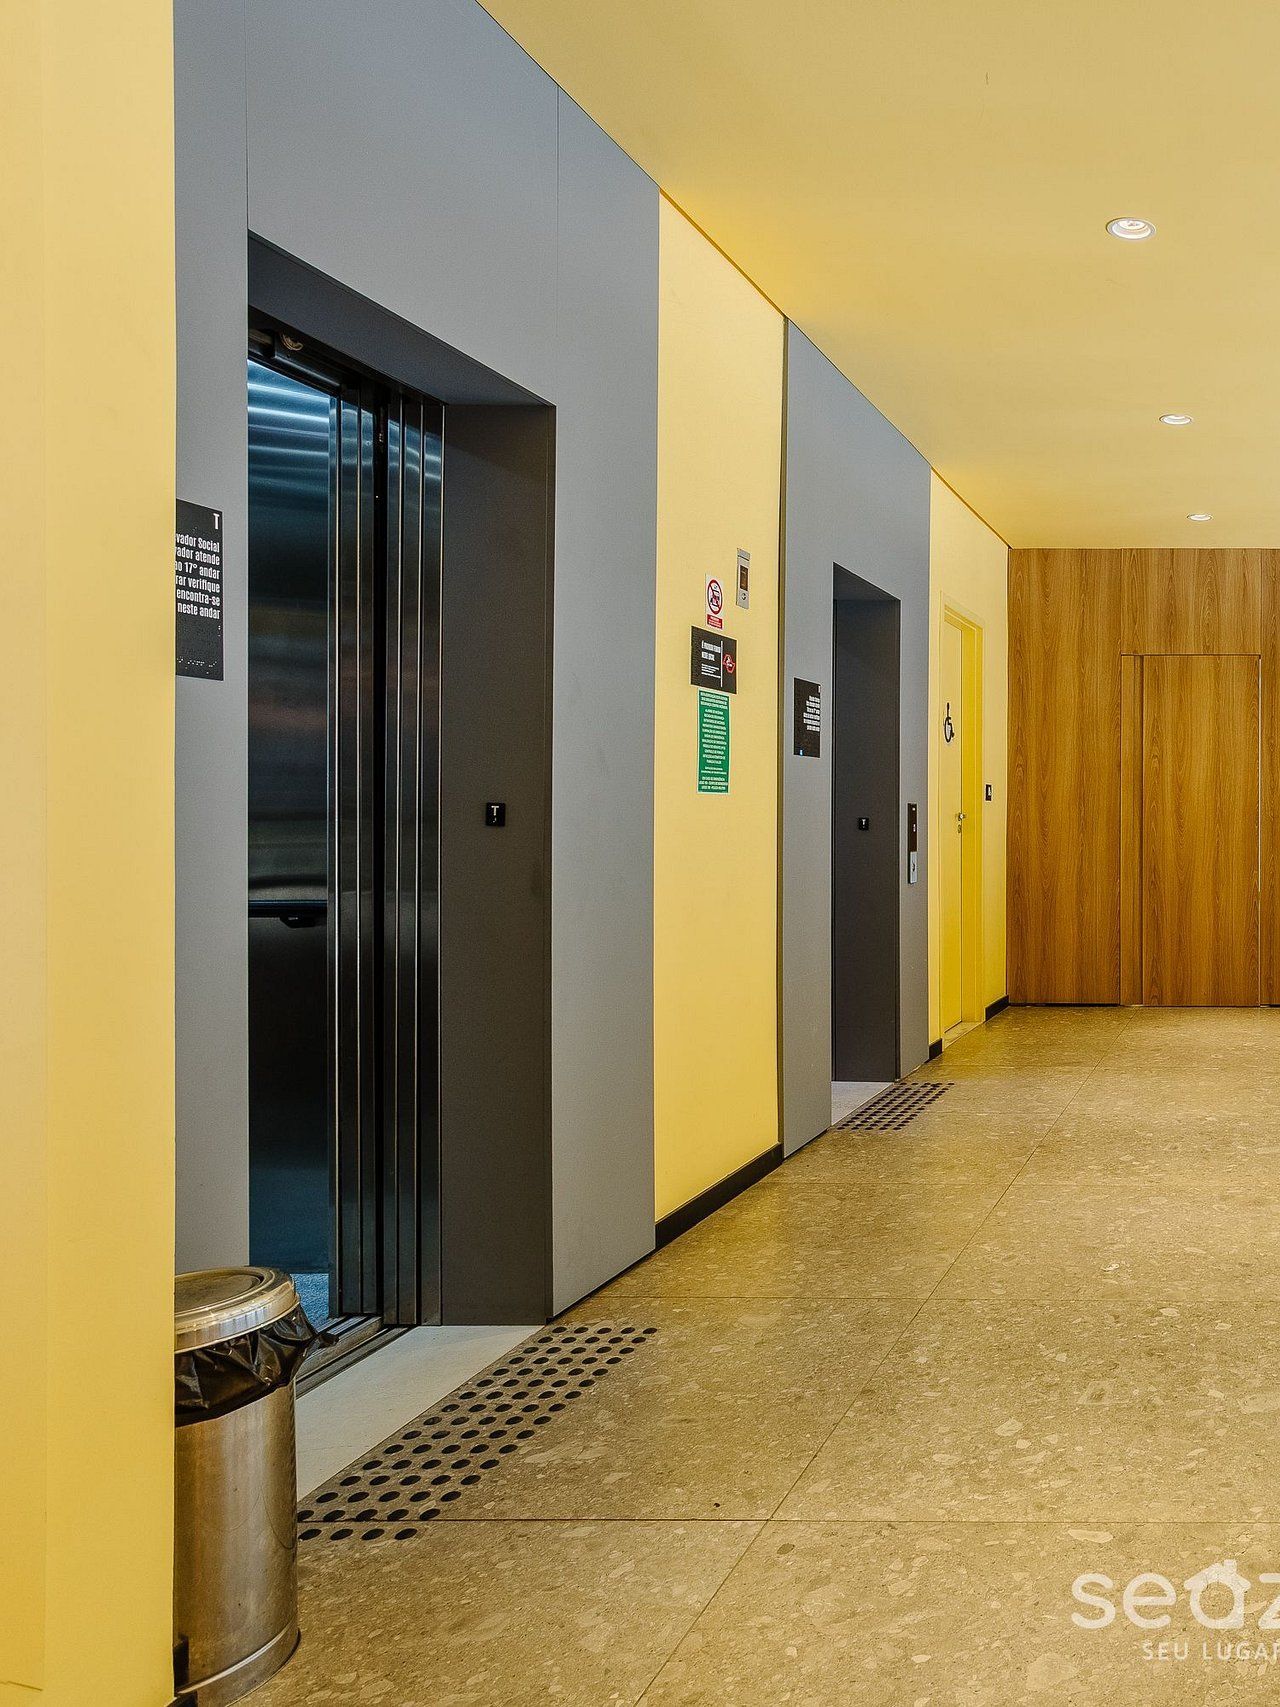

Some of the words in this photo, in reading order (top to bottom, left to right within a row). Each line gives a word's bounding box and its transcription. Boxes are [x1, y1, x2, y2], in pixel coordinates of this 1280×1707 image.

[213, 512, 220, 530] T
[176, 533, 197, 548] vador
[198, 537, 220, 553] Social
[175, 546, 194, 560] ador
[195, 550, 220, 566] atende
[199, 566, 220, 580] andar
[176, 575, 186, 587] rar
[188, 577, 220, 593] verifique
[176, 588, 220, 607] encontra-se
[177, 602, 198, 616] neste
[199, 607, 220, 620] andar
[491, 805, 500, 816] T
